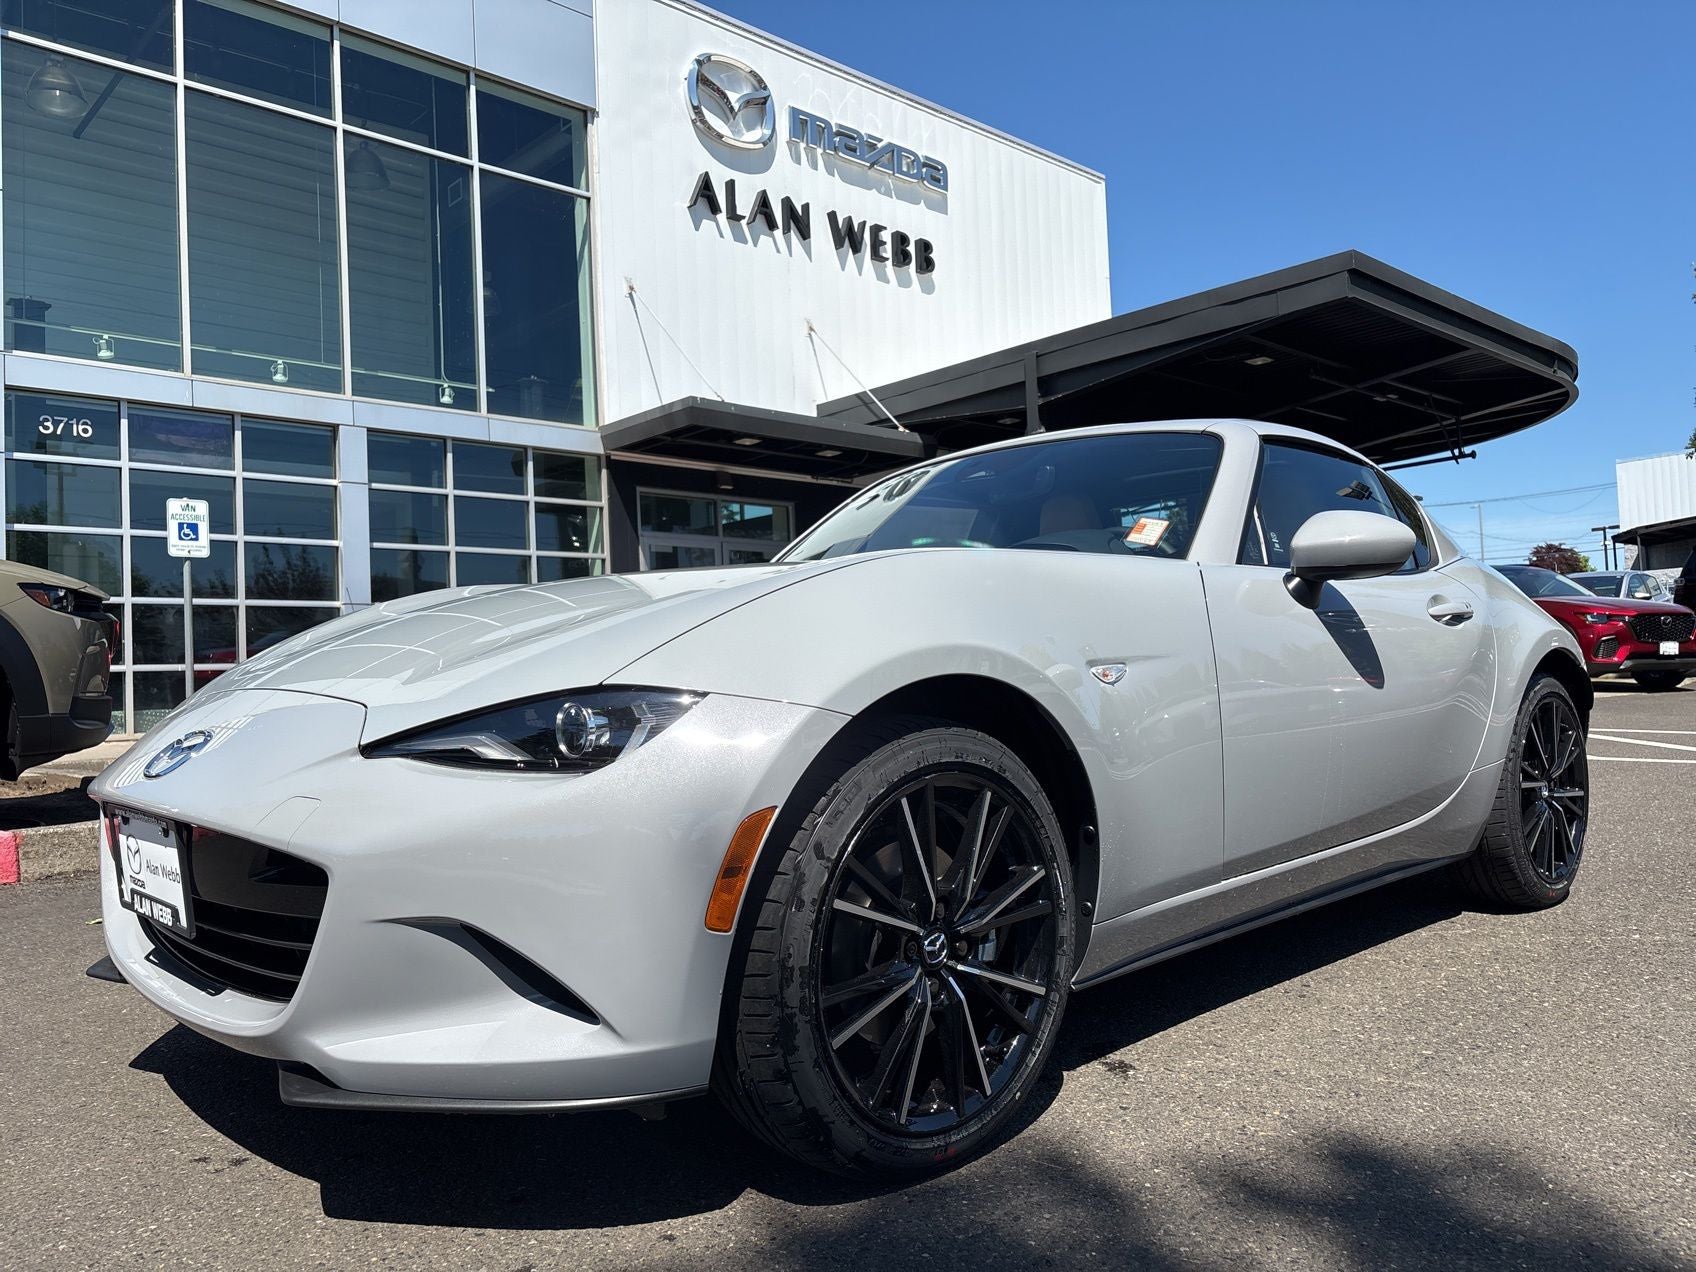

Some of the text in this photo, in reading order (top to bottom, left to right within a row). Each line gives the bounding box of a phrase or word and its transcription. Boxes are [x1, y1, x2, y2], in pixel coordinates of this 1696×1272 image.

[687, 171, 936, 275] ALAN WEBB
[38, 414, 93, 438] 3716
[170, 513, 206, 522] ACCESSIBLE
[180, 503, 196, 513] VAN
[145, 858, 181, 884] Alan Webb
[133, 894, 173, 927] ALAN WEBB
